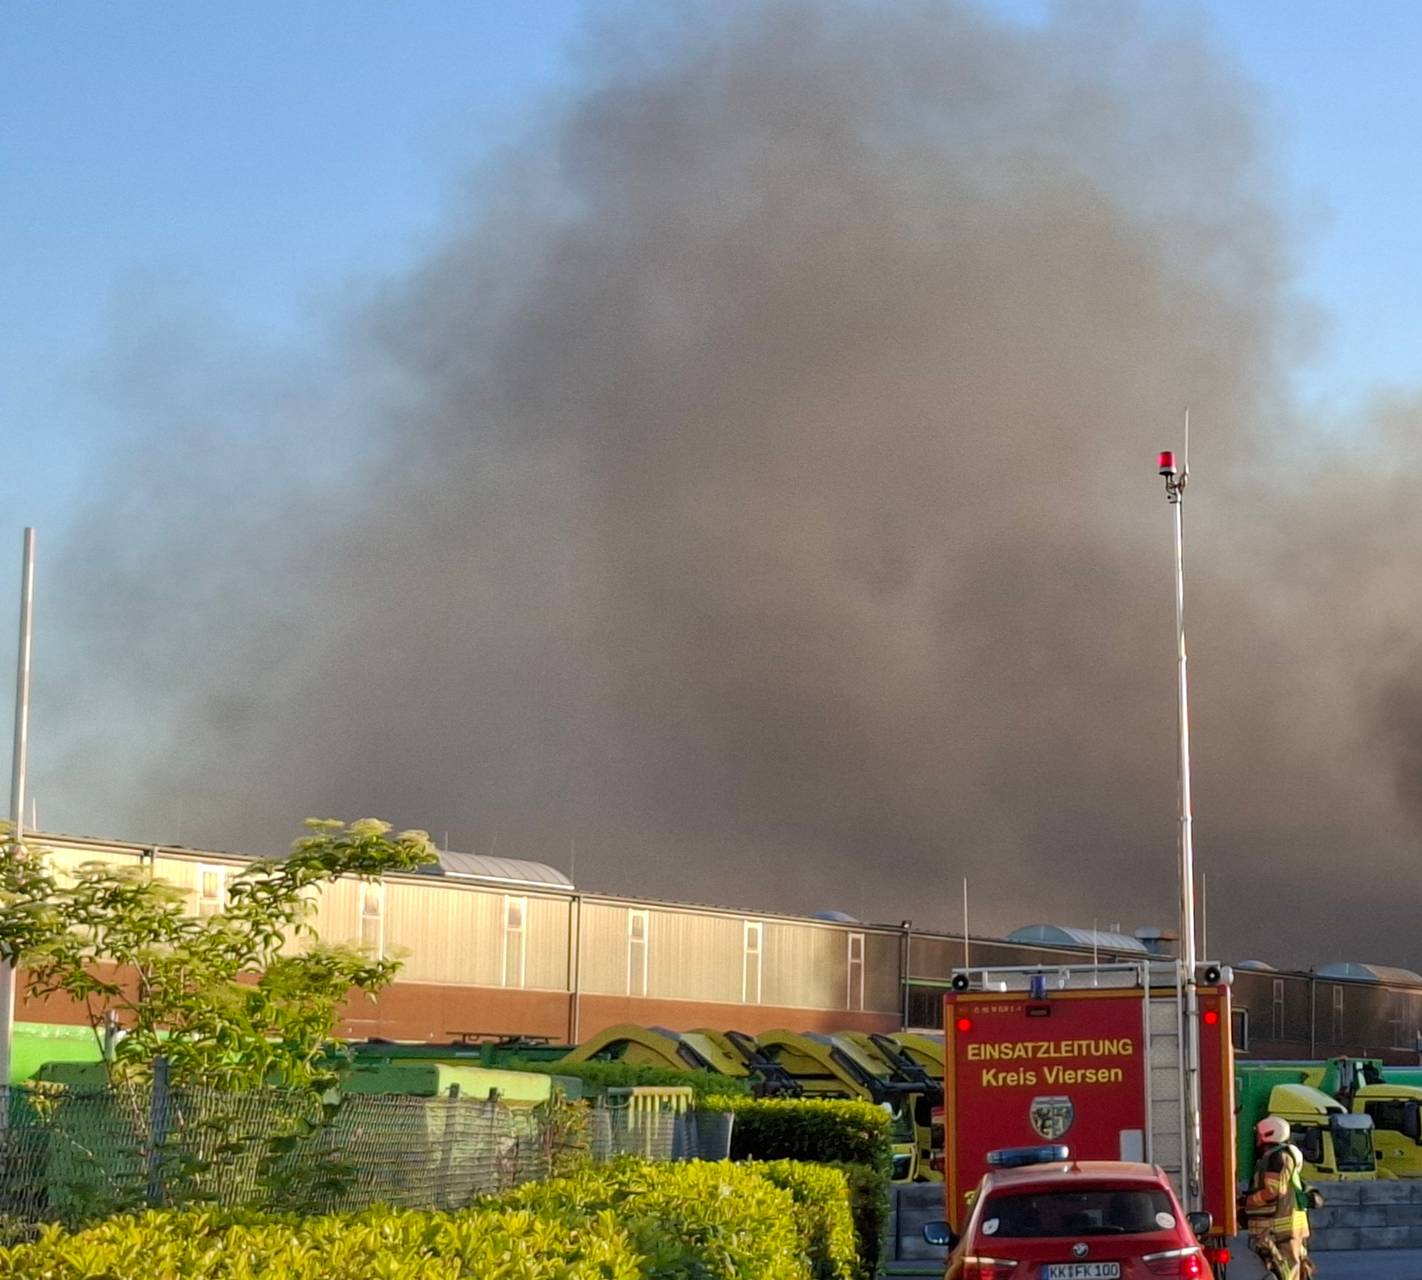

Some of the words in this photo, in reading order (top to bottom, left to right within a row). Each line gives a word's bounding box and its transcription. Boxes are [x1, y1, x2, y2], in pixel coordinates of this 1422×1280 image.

[967, 1038, 1134, 1060] EINSATZLEITUNG
[982, 1067, 1037, 1087] Kreis
[1043, 1065, 1123, 1085] Viersen
[1050, 1265, 1067, 1278] KK
[1094, 1263, 1119, 1277] 100
